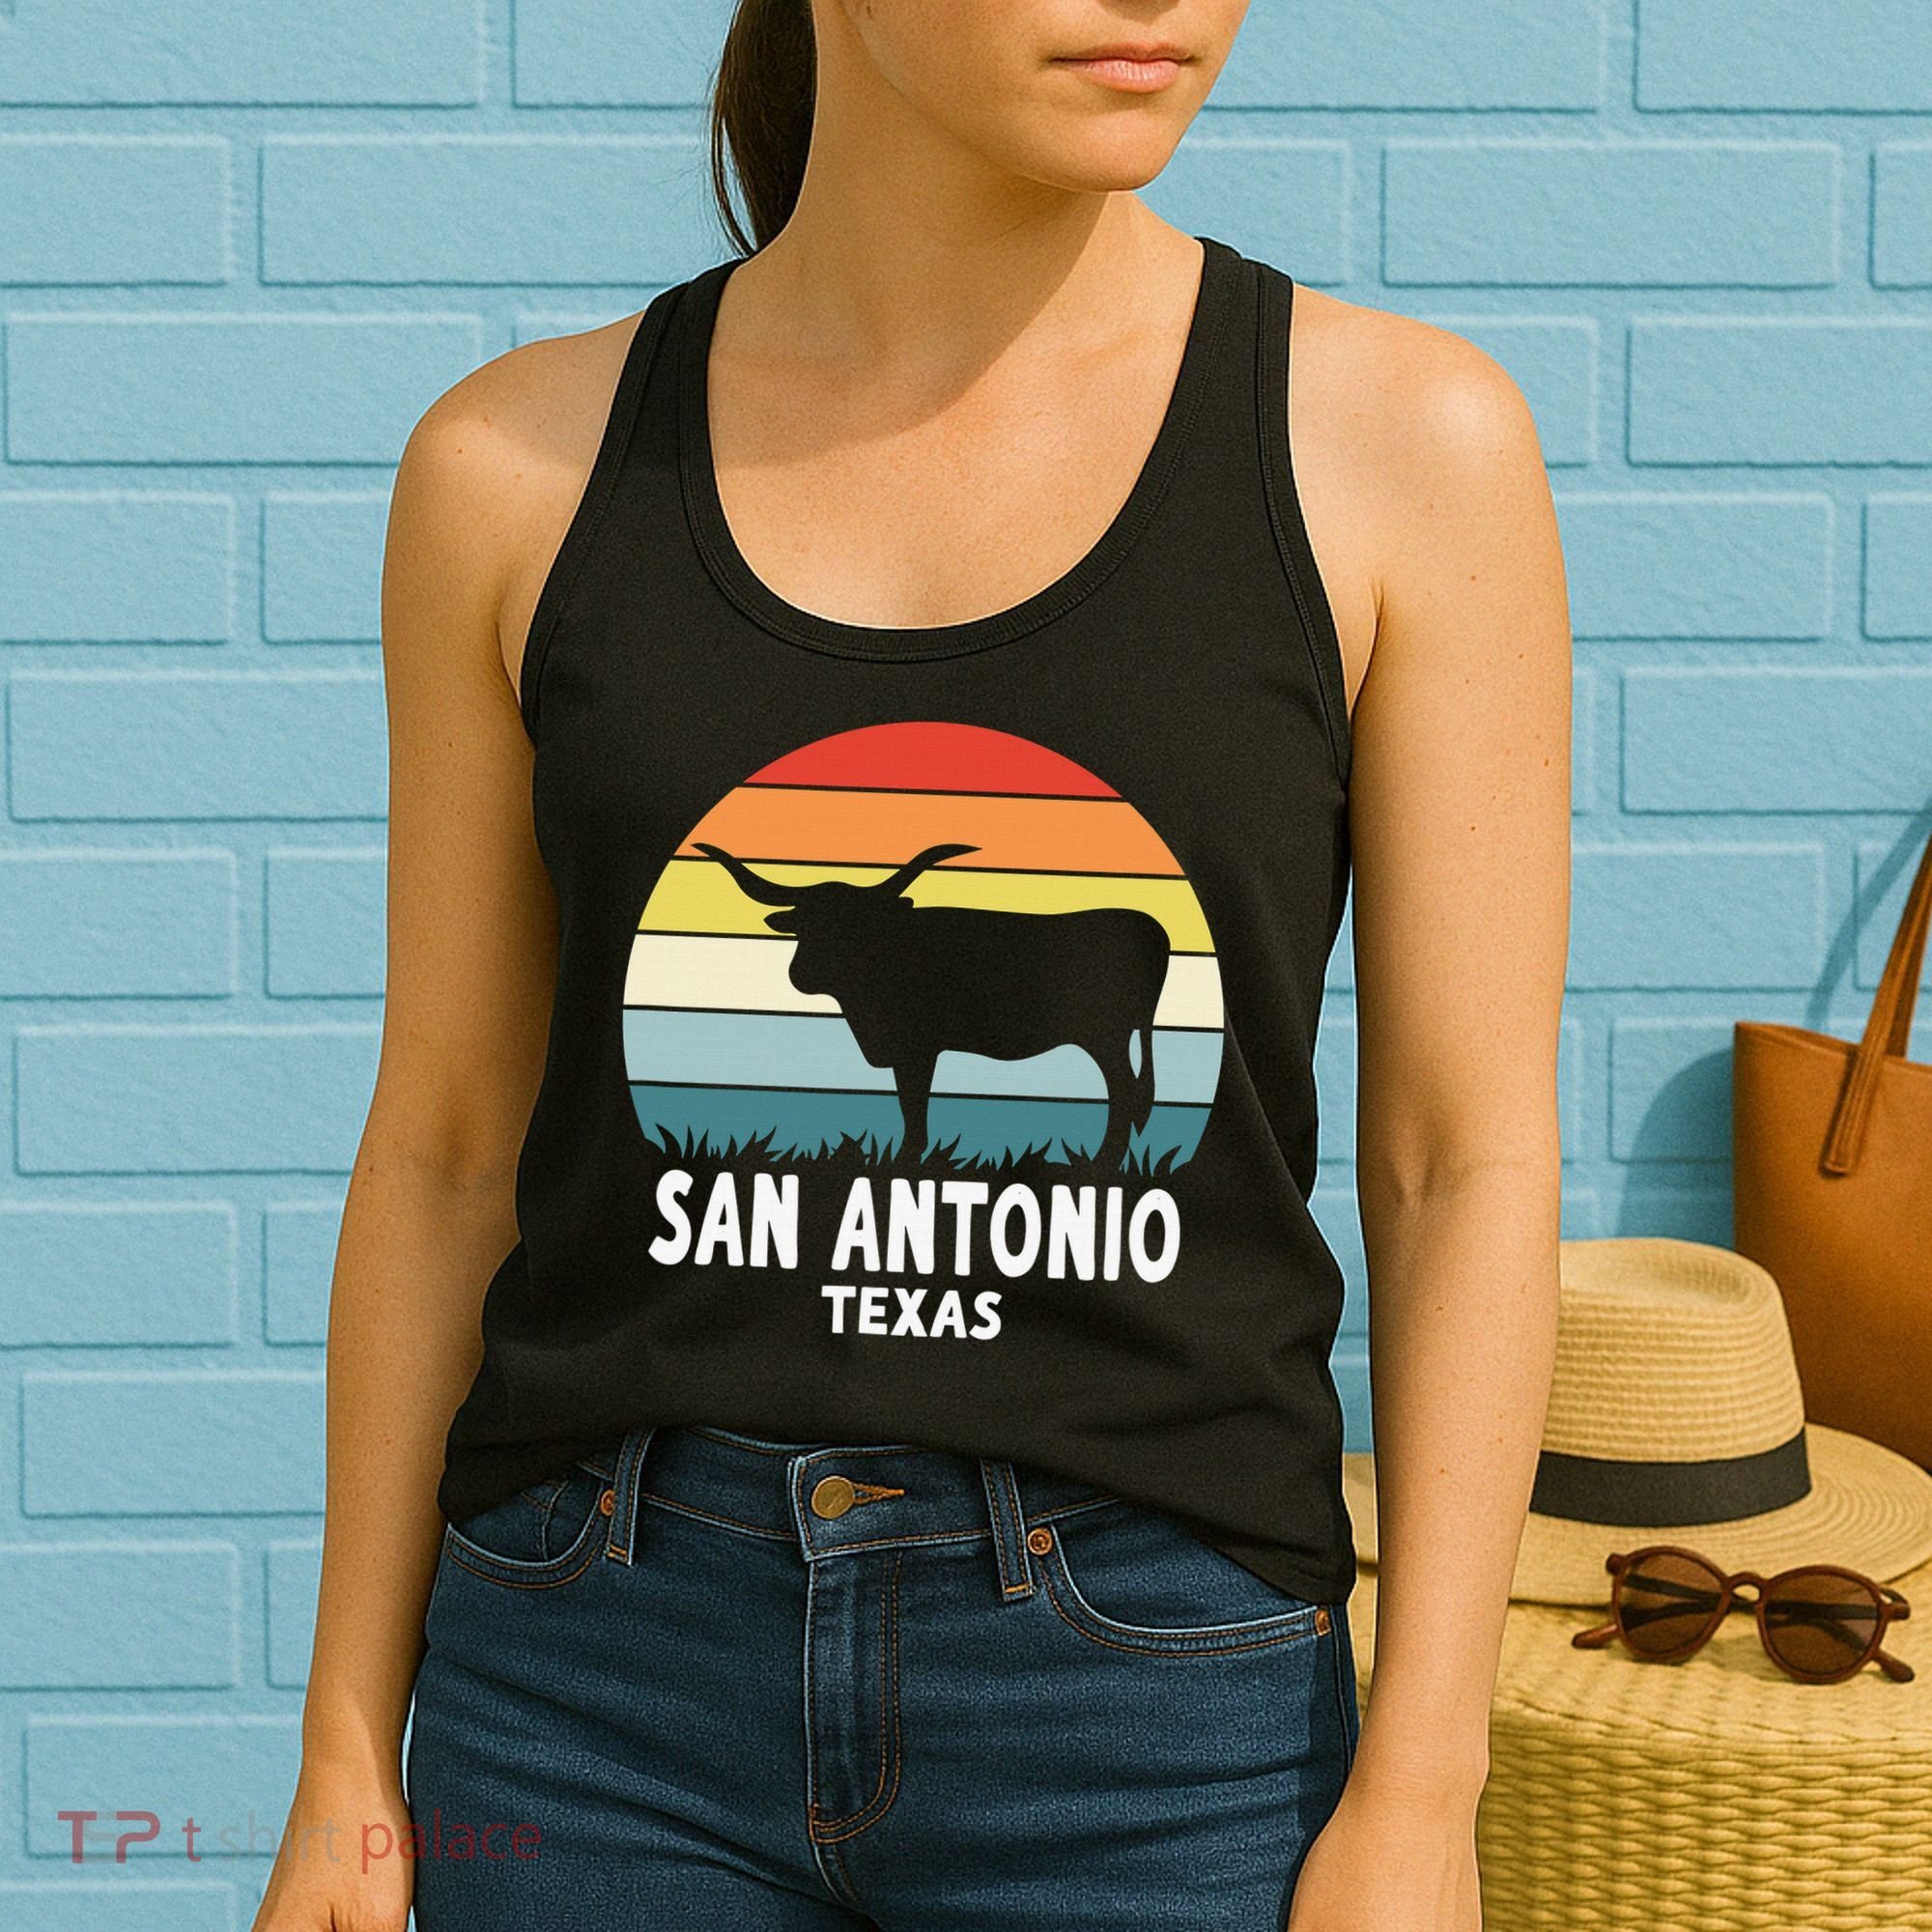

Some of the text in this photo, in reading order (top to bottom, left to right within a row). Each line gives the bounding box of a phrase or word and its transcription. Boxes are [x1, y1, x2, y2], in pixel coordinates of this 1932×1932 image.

[648, 1169, 1180, 1284] SAN ANTONIO
[821, 1285, 1003, 1341] TEXAS
